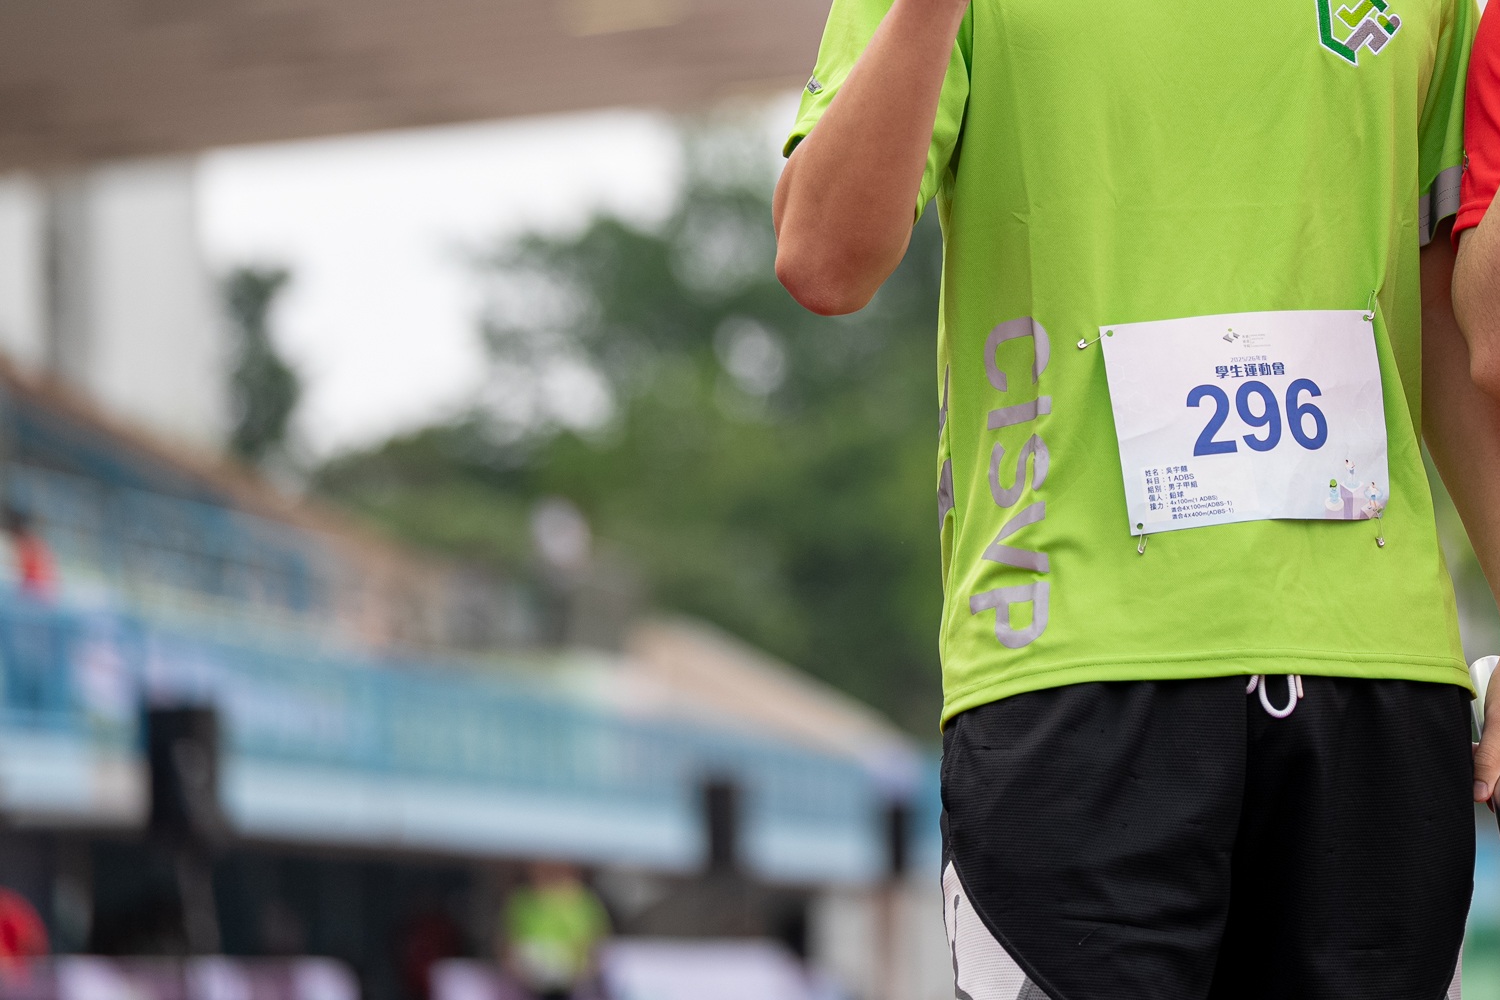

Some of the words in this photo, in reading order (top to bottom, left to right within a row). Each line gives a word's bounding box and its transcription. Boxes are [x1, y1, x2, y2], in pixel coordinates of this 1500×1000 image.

[1215, 362, 1285, 379] 學生運動會
[1186, 378, 1328, 457] 296
[969, 316, 1052, 649] CISVP
[1173, 473, 1195, 482] ADBS
